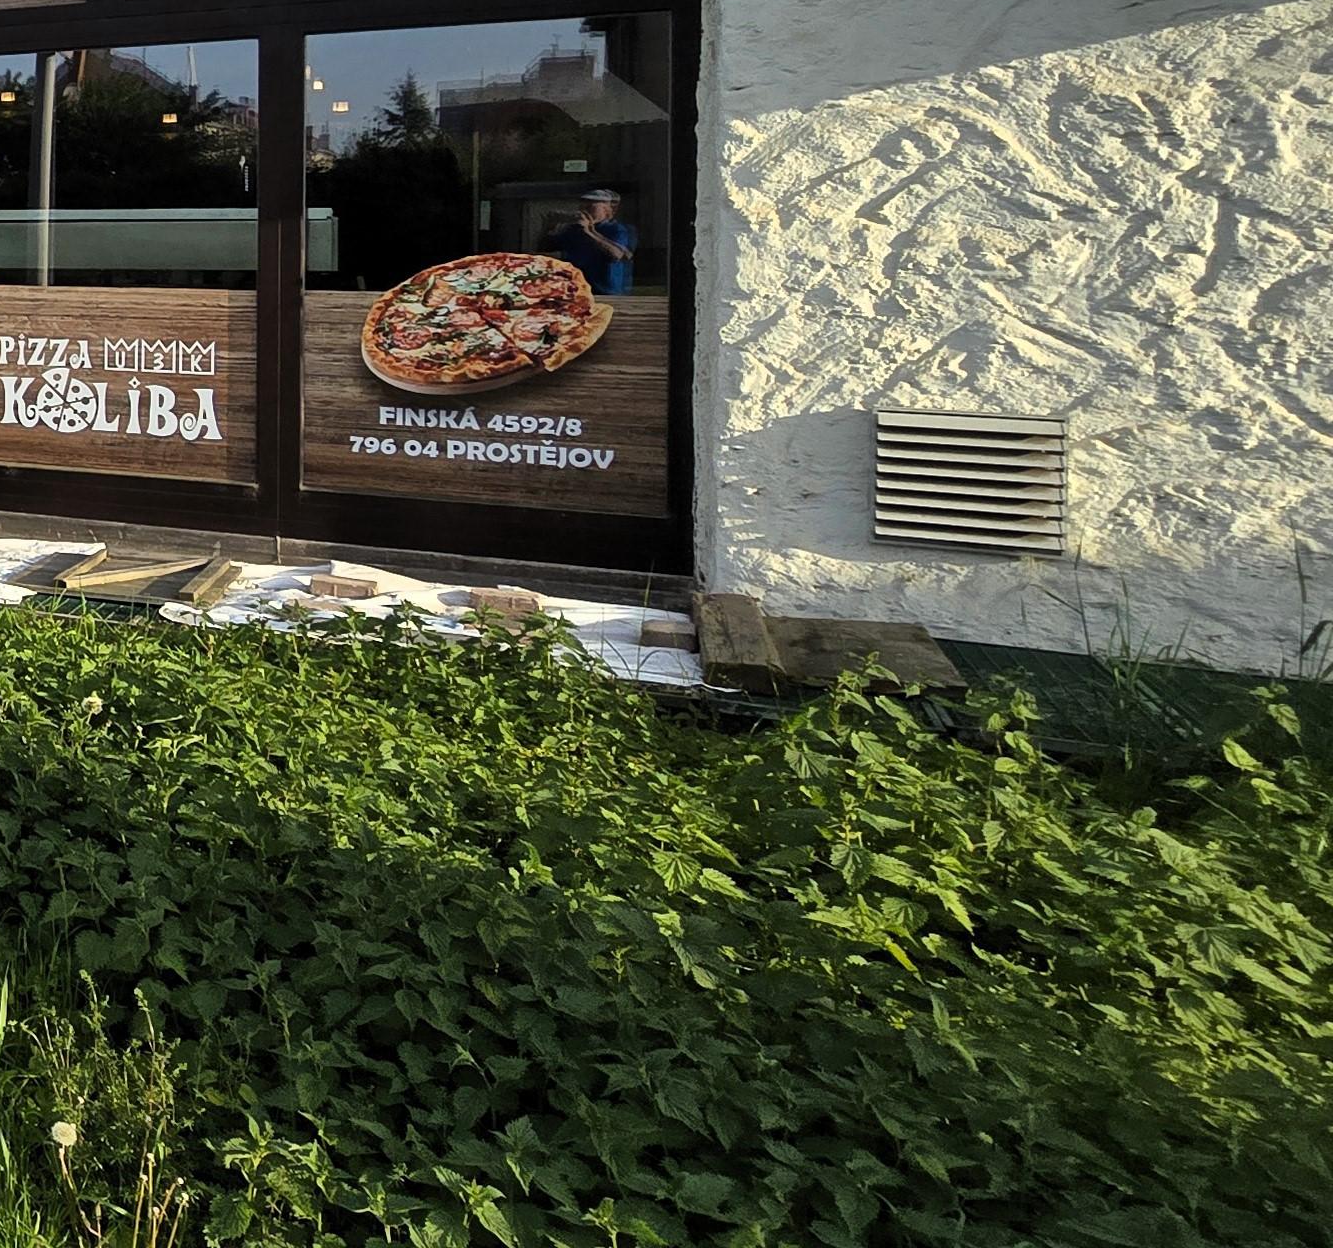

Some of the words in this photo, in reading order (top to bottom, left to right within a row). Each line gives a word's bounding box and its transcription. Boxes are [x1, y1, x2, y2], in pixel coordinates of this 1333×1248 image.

[378, 406, 480, 431] FINSKÁ
[487, 414, 582, 437] 4592/8
[349, 435, 396, 454] 796
[404, 439, 439, 458] 04
[446, 440, 615, 470] PROSTĚJOV
